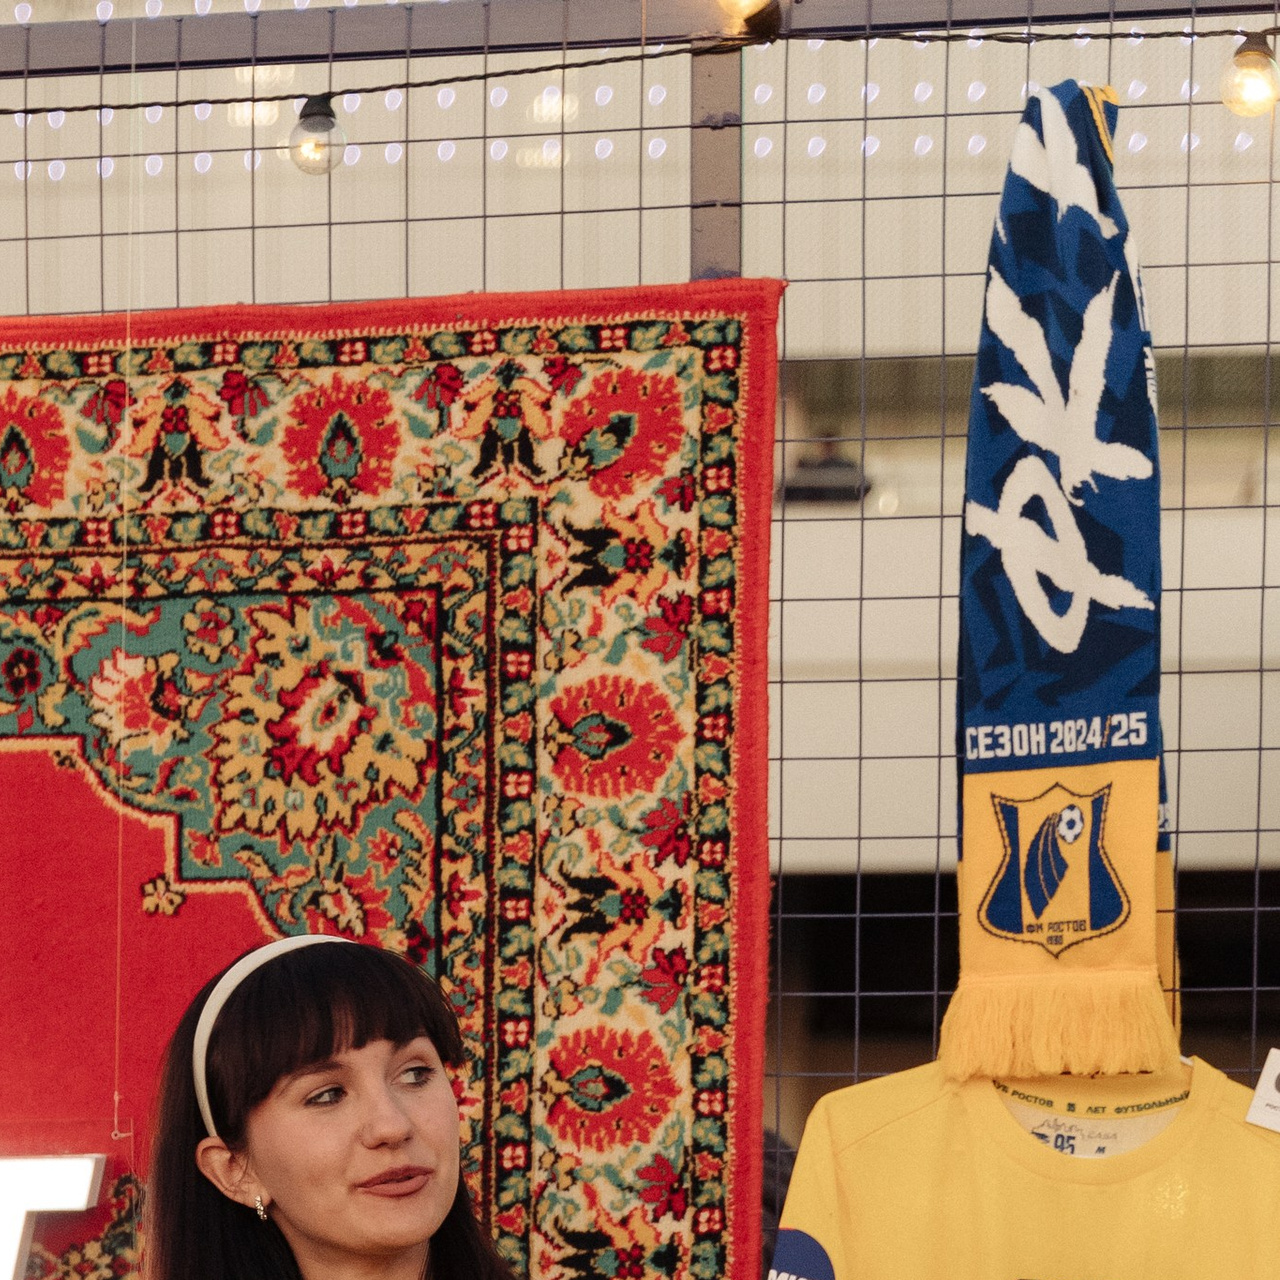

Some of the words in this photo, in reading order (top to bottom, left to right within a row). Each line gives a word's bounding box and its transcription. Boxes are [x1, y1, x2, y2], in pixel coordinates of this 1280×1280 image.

[965, 723, 1046, 760] СЕЗОН
[1050, 711, 1148, 755] 2024/25
[1011, 1090, 1054, 1108] РОСТОВ
[1086, 1106, 1107, 1114] ЛЕТ
[1114, 1090, 1190, 1114] ФУТБОЛЬНЫЙ
